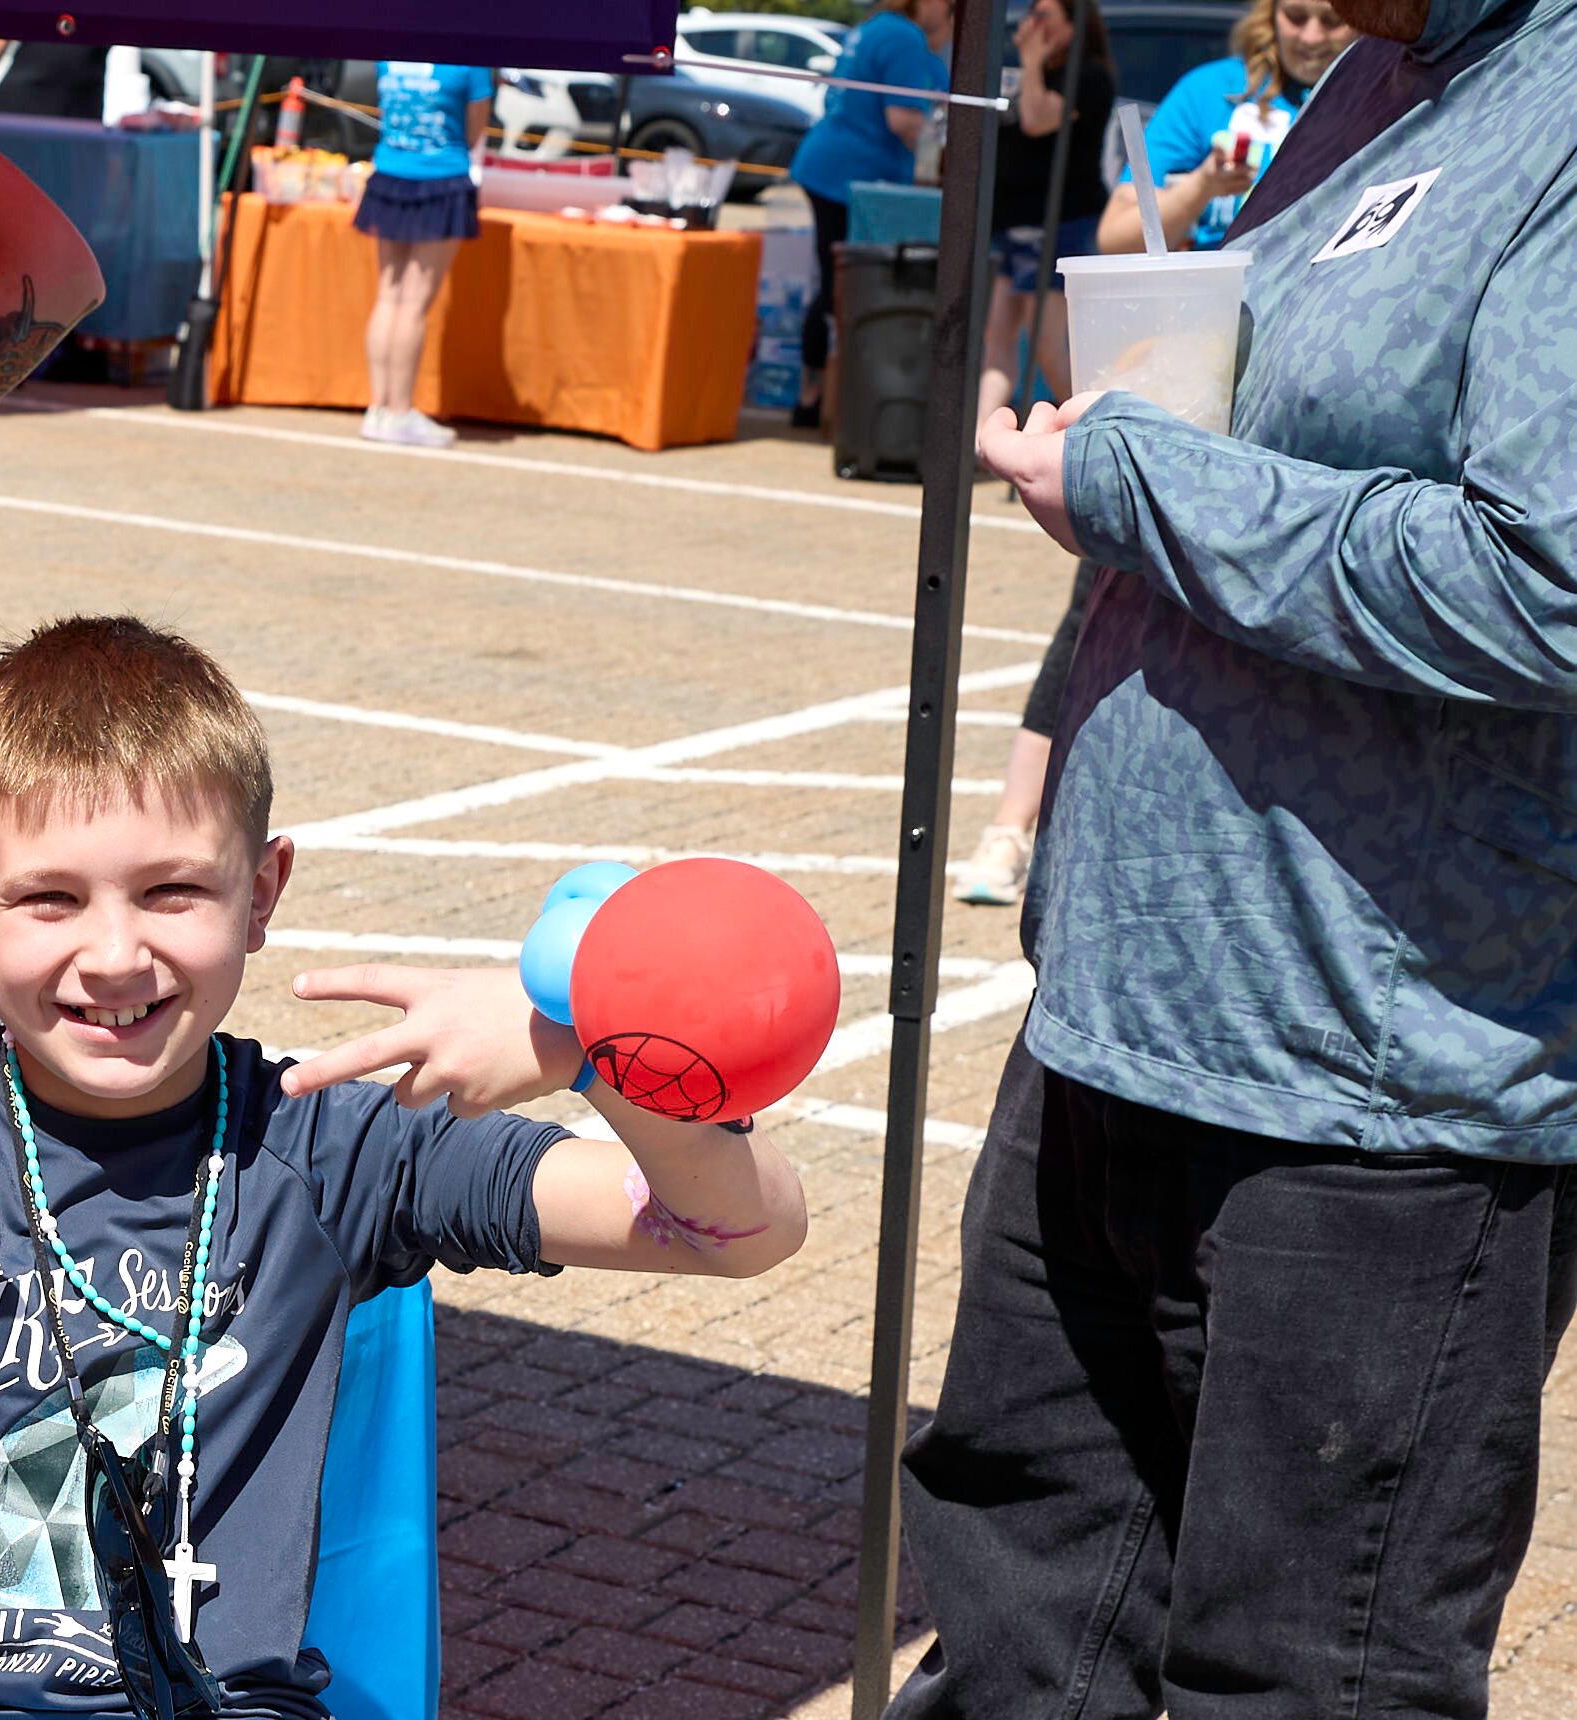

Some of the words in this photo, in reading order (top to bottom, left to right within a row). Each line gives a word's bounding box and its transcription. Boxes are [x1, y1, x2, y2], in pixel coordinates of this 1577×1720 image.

[118, 1248, 246, 1318] Sesons
[180, 1241, 194, 1294] Cochlear
[164, 1359, 179, 1414] Cochlear
